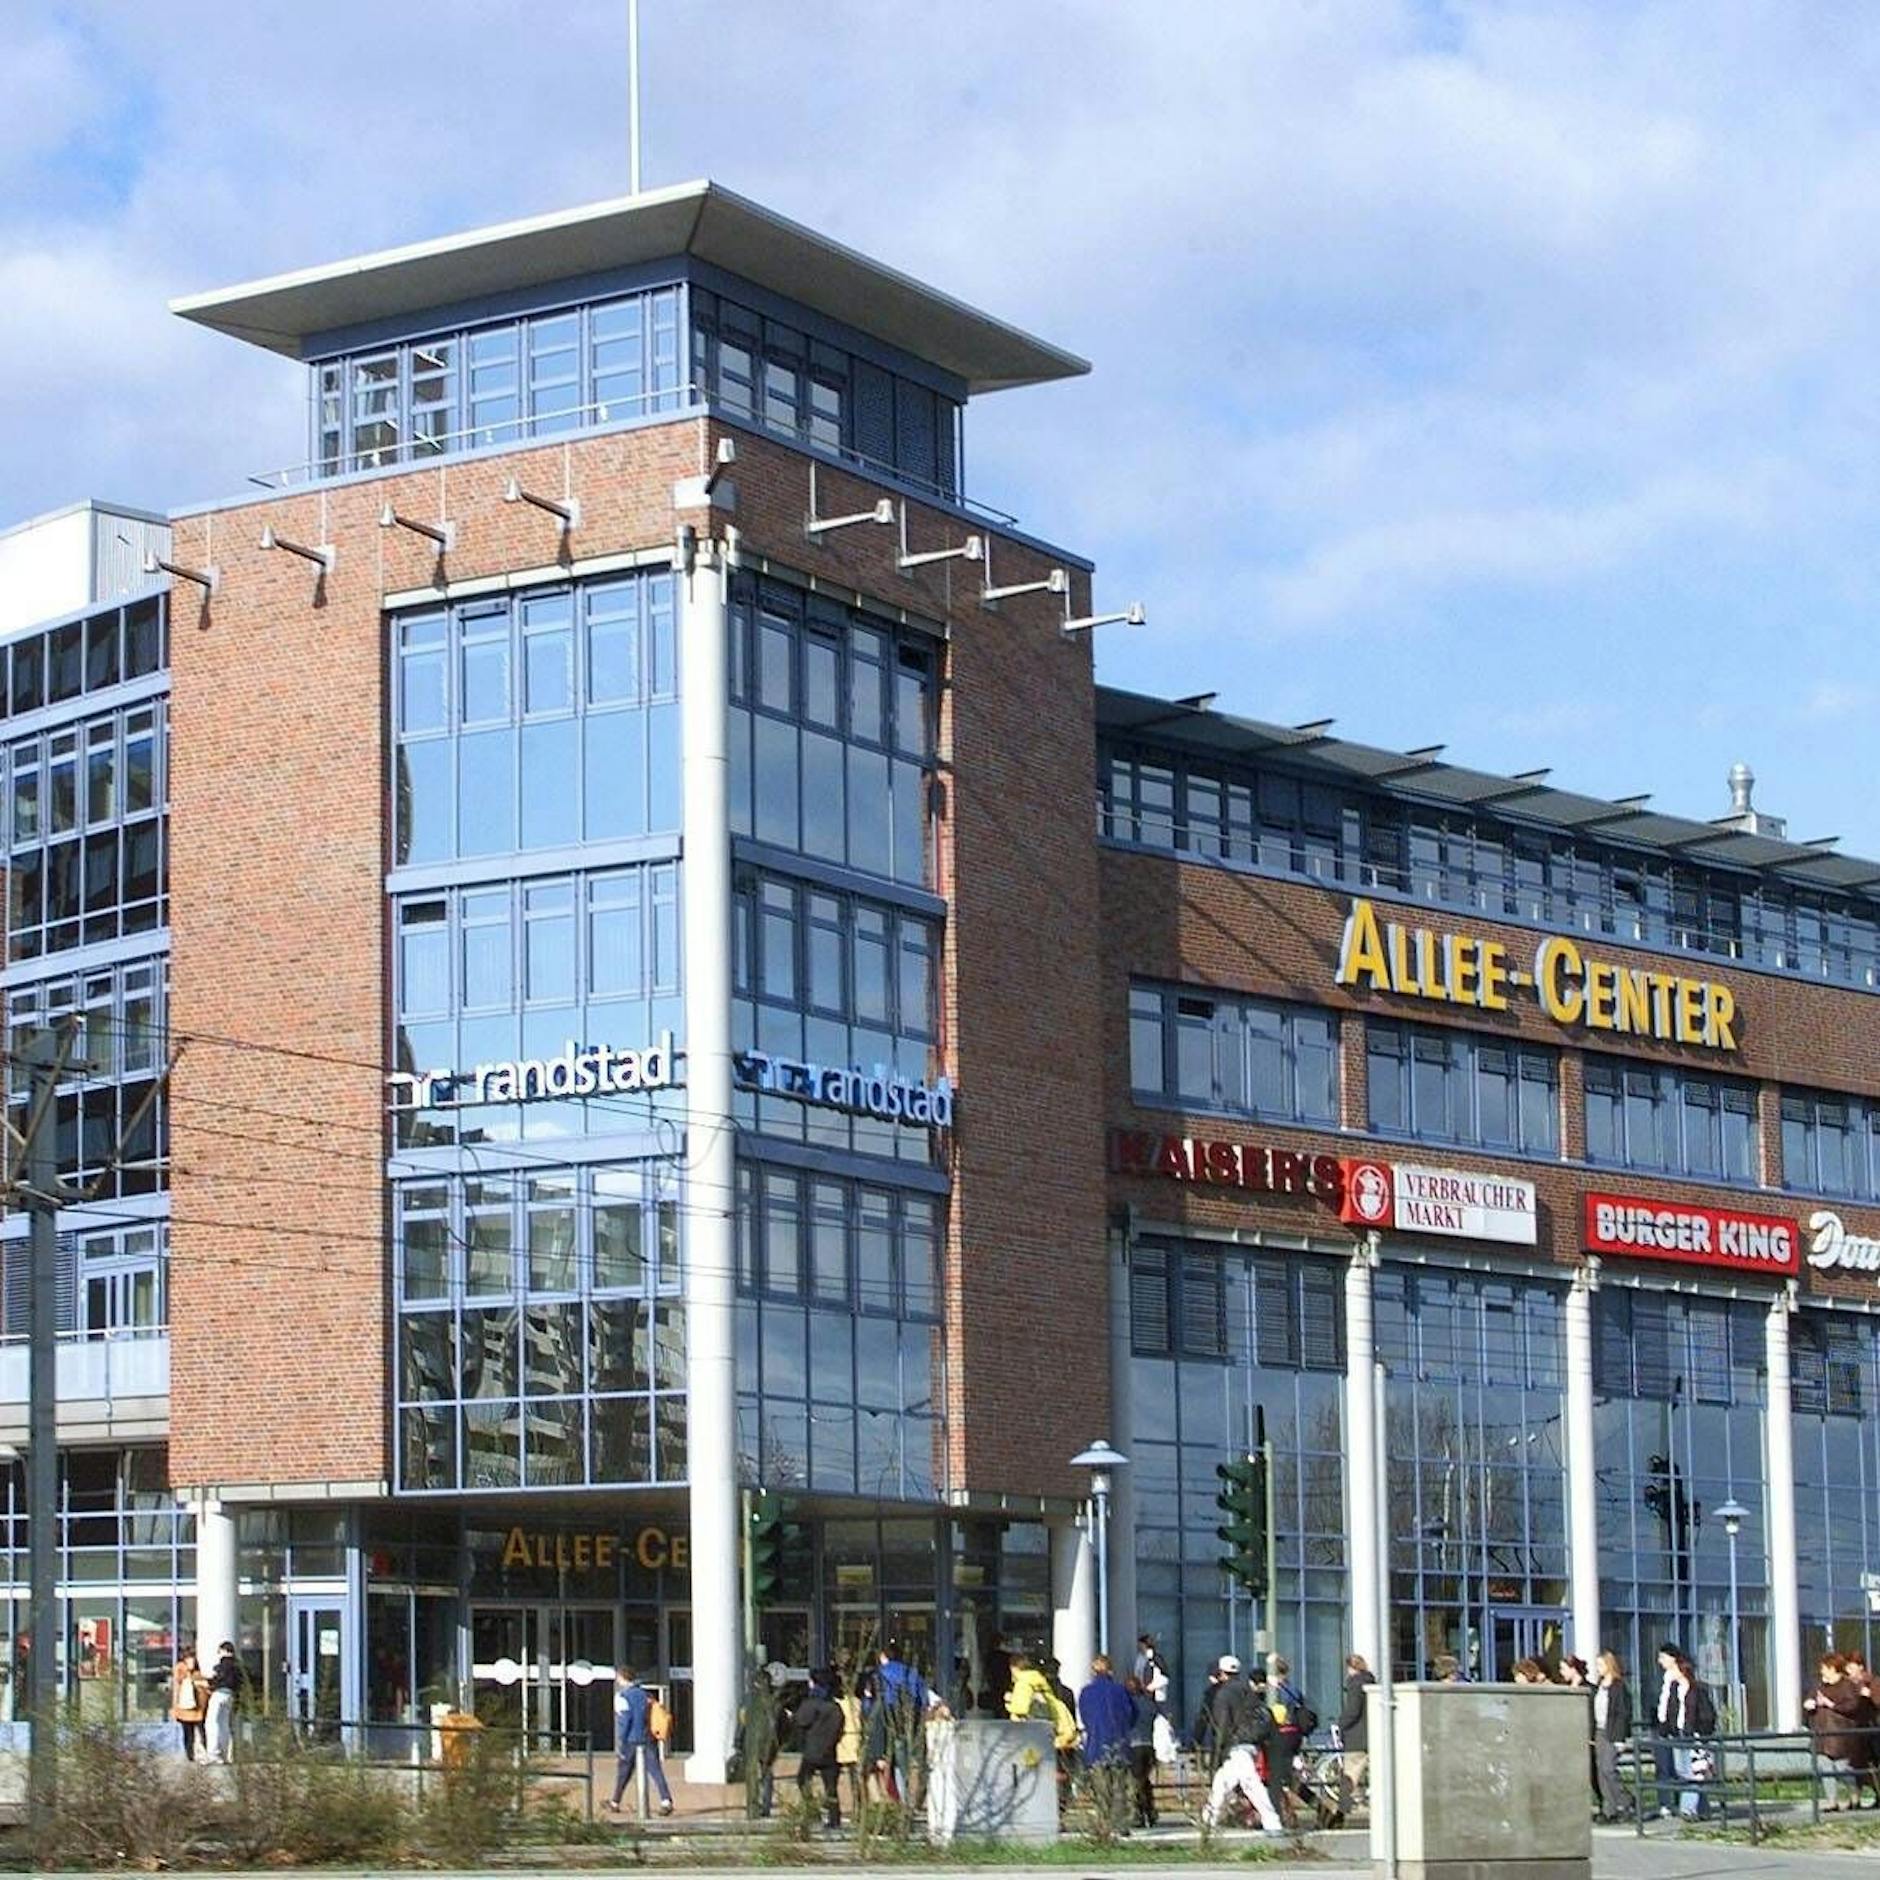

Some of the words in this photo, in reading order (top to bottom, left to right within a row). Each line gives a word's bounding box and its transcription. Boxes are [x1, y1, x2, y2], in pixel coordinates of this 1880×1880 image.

[1335, 898, 1735, 1050] ALLEE-CENTER
[475, 1029, 671, 1100] randstad
[814, 1065, 952, 1126] randstad
[1405, 1173, 1527, 1211] VERBRAUCHER
[1407, 1201, 1464, 1230] MARKT
[1596, 1203, 1712, 1253] BURGER
[1718, 1219, 1791, 1264] KING
[503, 1526, 690, 1569] ALLEE-CE
